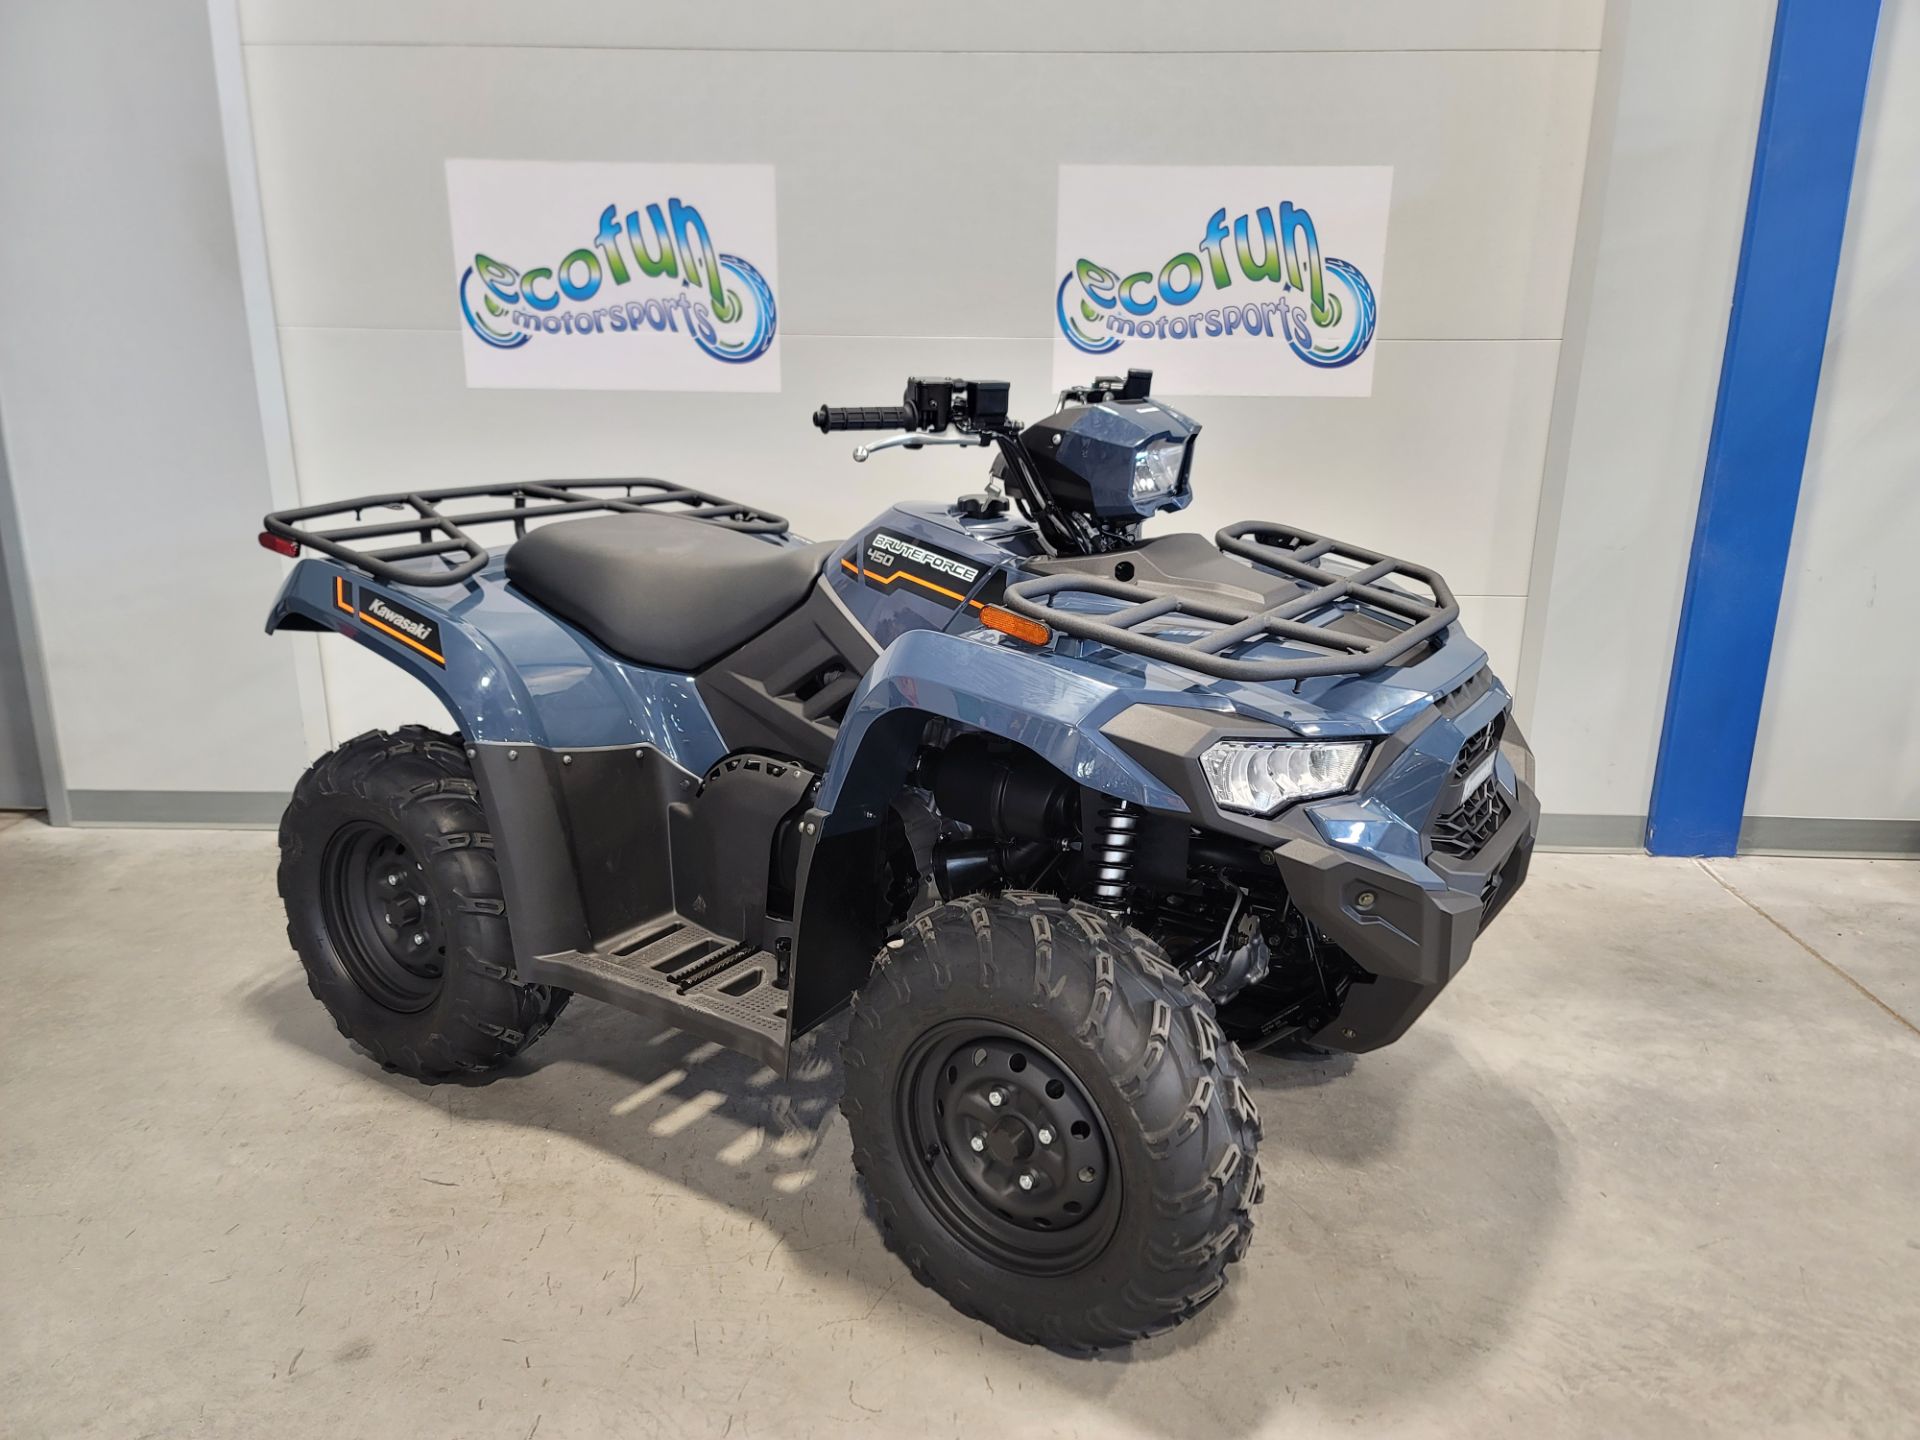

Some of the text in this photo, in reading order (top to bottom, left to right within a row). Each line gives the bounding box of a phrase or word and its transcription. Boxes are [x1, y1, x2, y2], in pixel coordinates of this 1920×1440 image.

[512, 293, 718, 346] motorsports
[1106, 297, 1313, 350] motorsports
[867, 548, 894, 567] 450
[368, 598, 432, 640] Kawasaki
